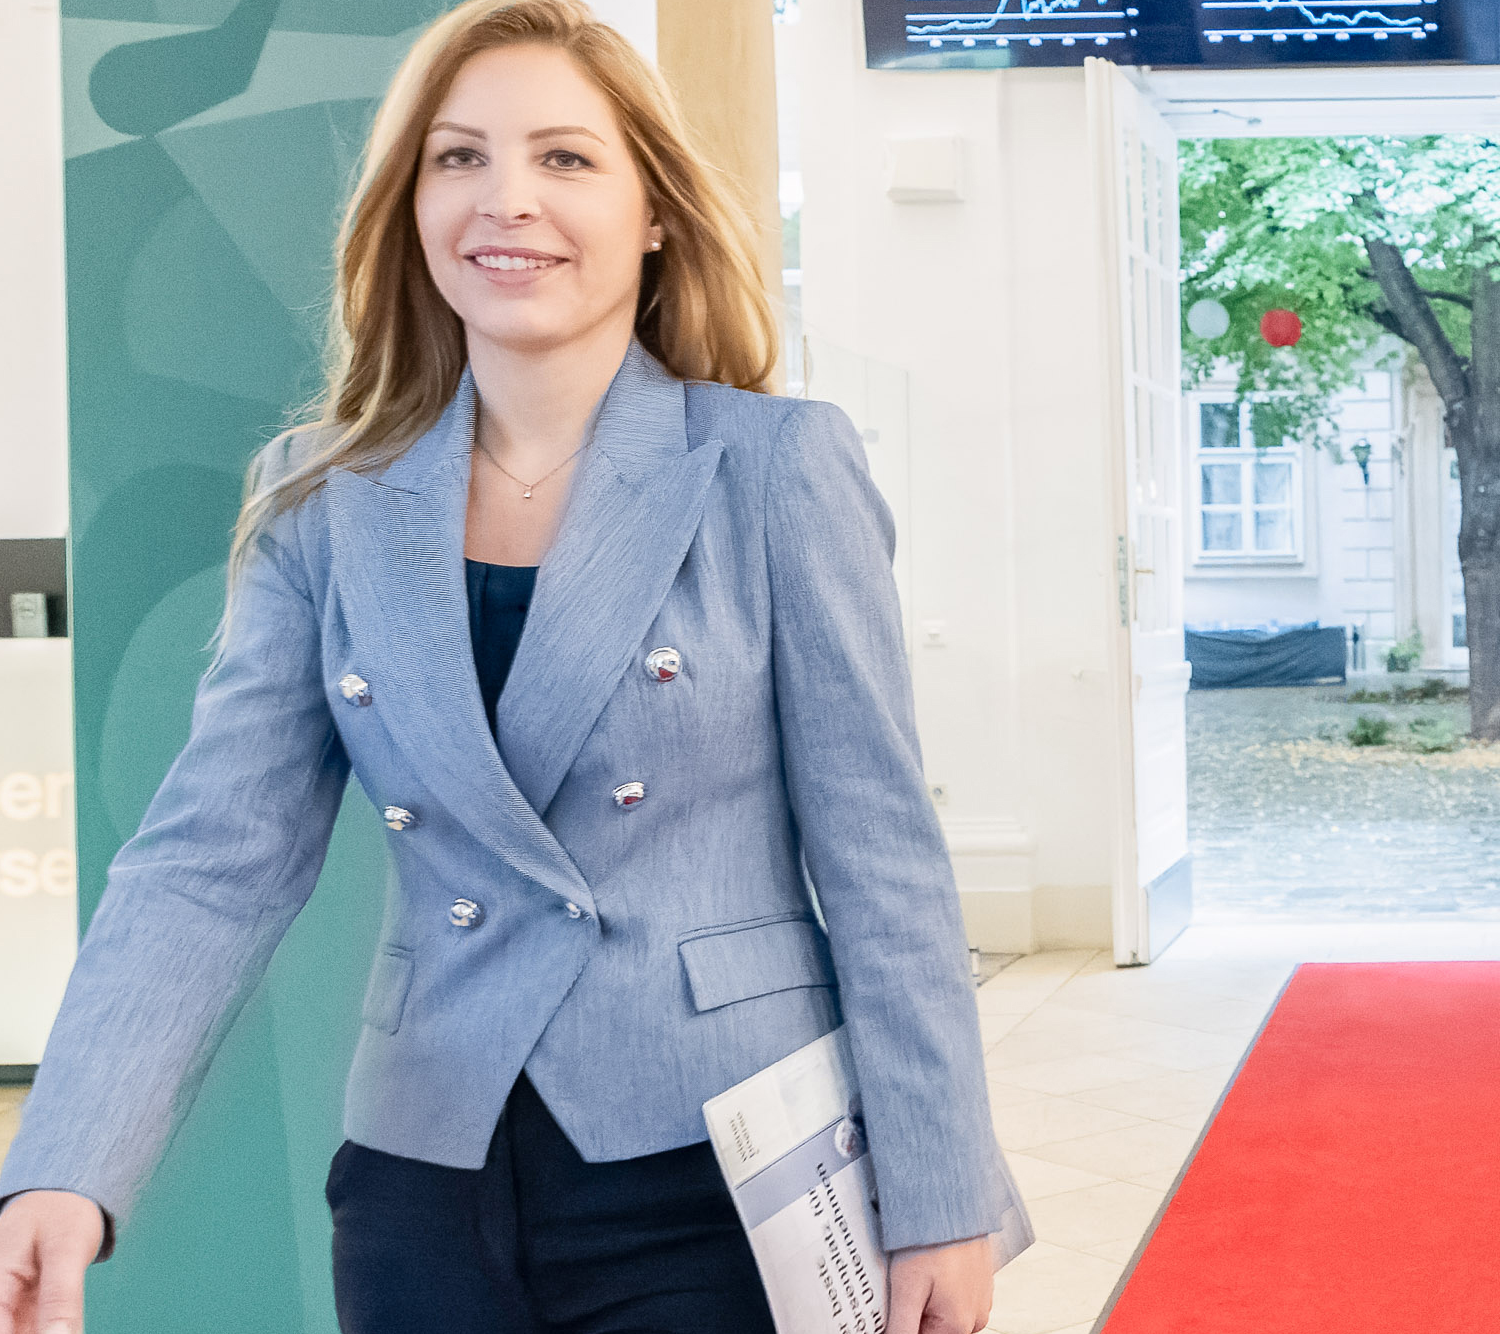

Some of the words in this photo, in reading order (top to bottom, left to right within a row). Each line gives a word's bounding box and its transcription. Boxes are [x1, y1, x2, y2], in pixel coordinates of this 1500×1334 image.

[807, 1186, 824, 1218] für
[816, 1162, 875, 1305] Unternehmen
[815, 1253, 845, 1320] beste
